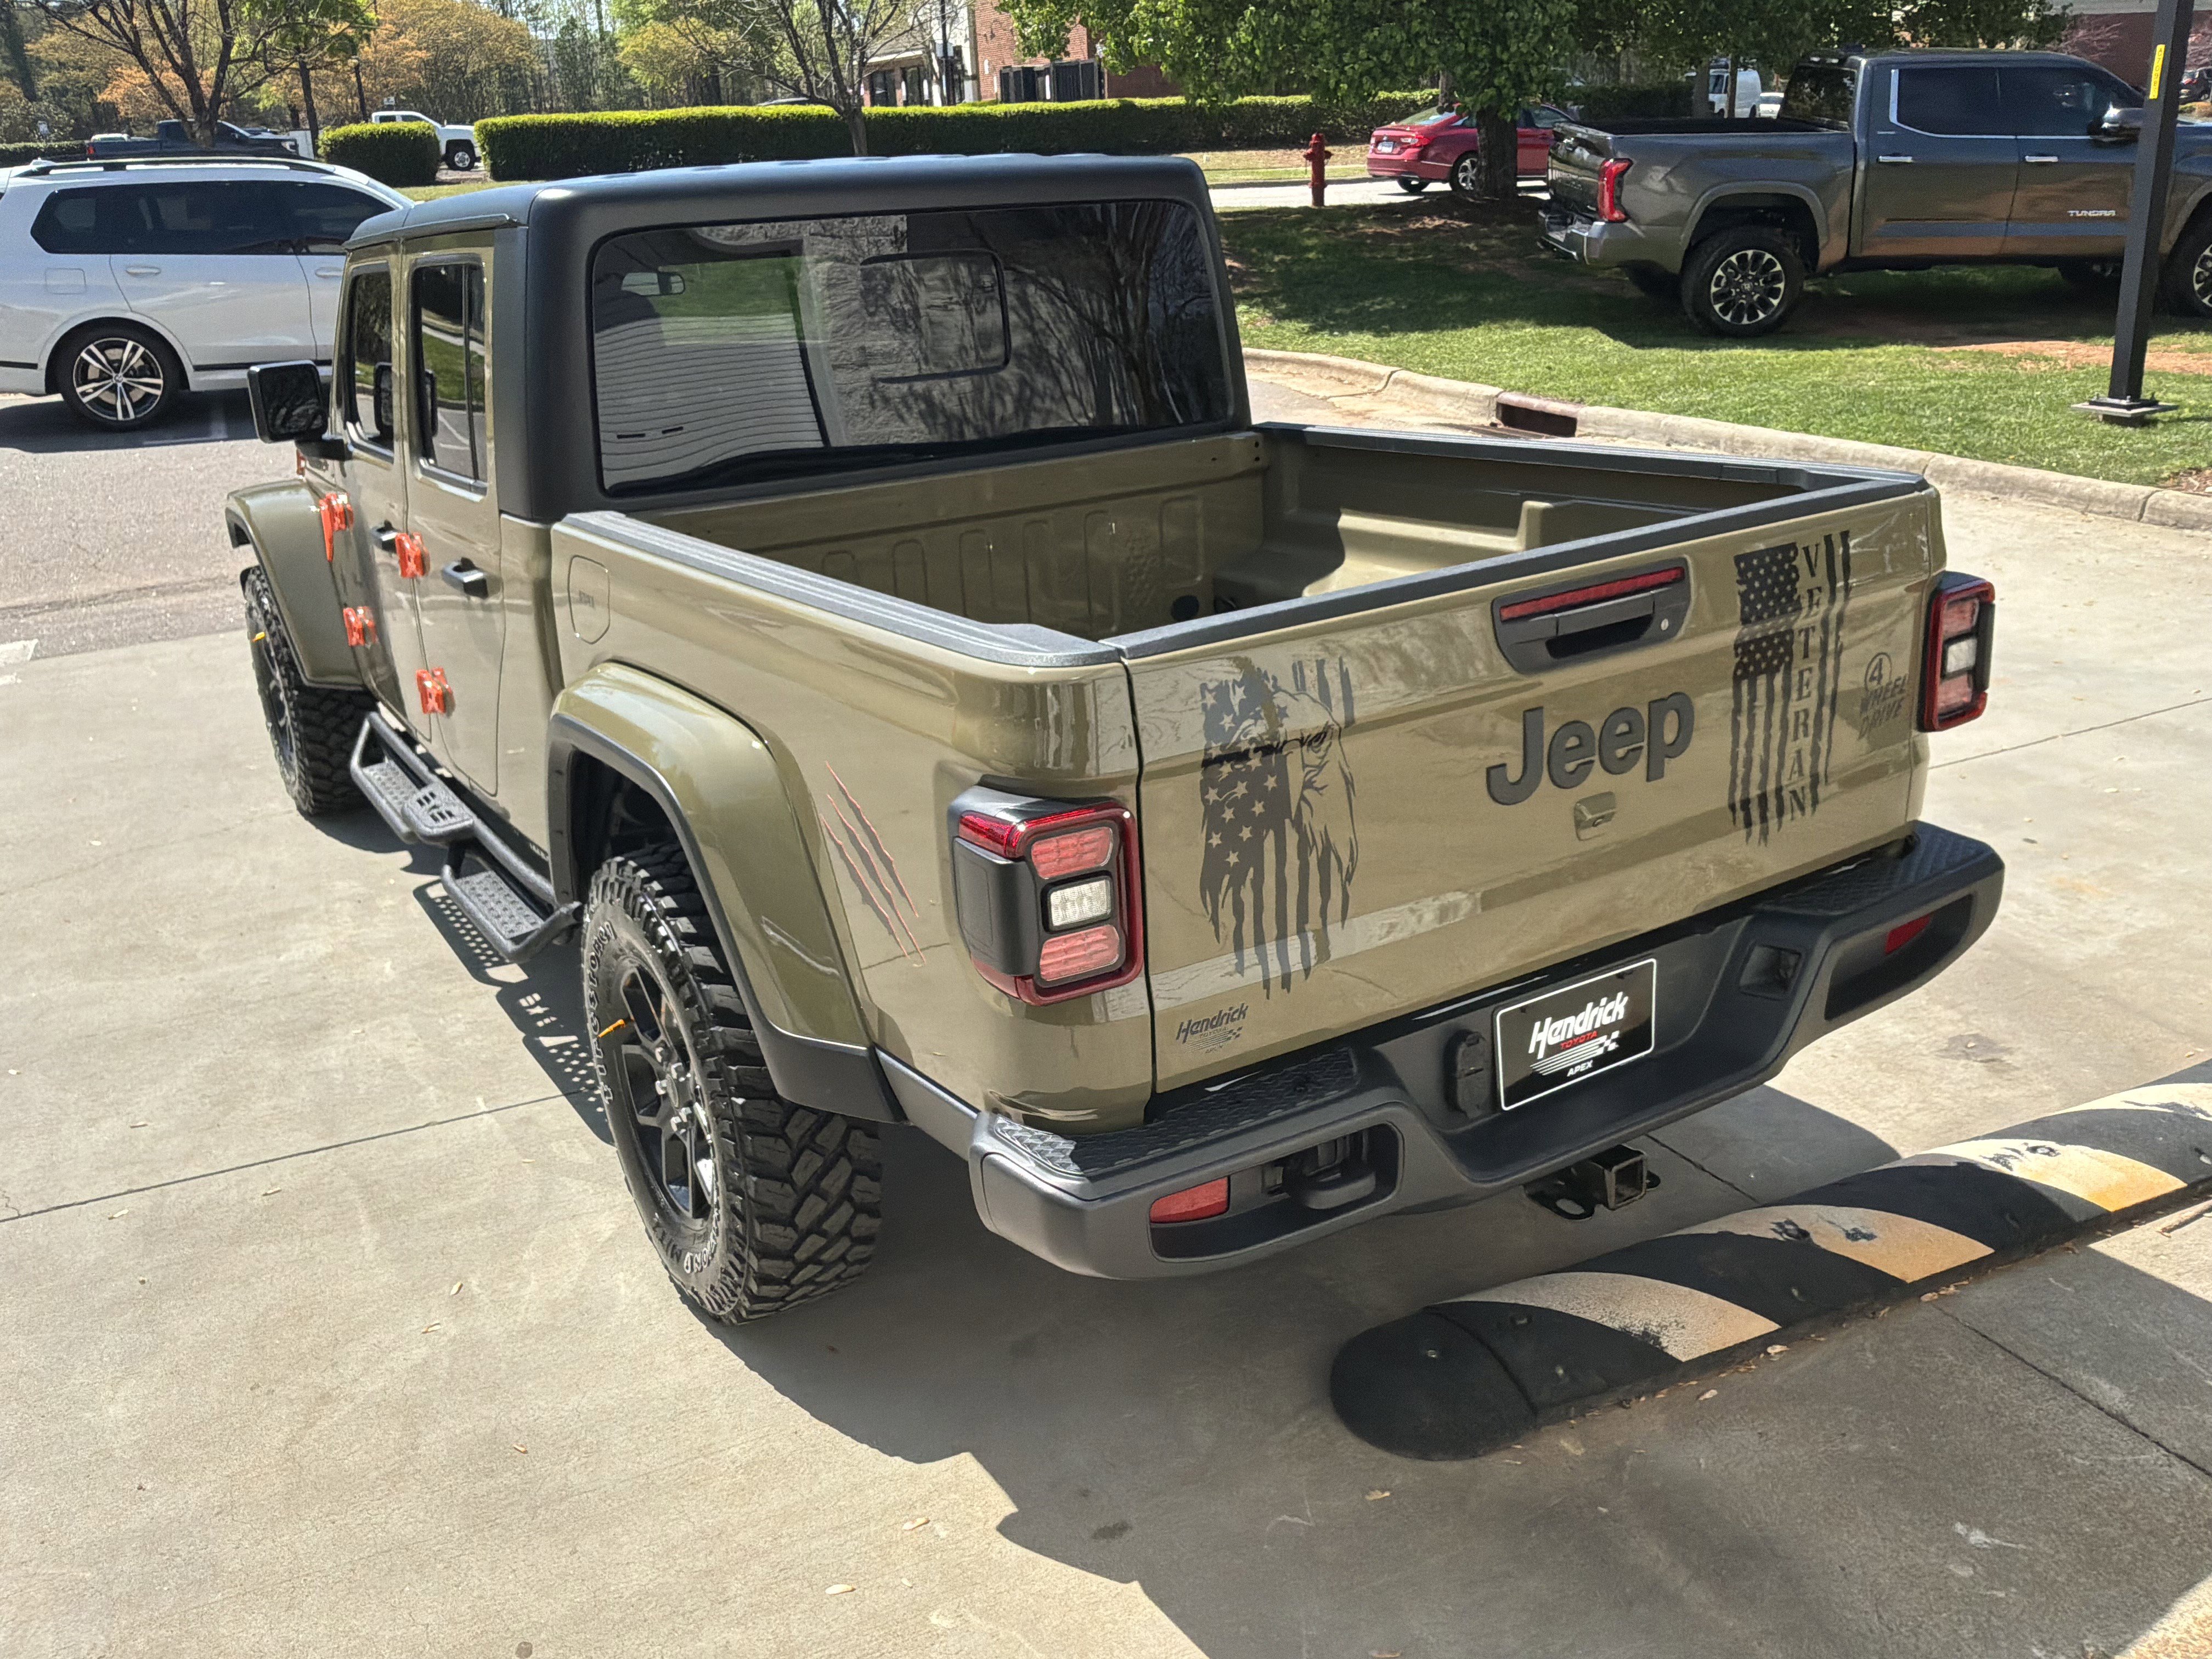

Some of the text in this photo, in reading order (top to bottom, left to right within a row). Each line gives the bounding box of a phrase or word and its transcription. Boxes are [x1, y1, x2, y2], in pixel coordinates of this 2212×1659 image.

[1788, 543, 1822, 821] VETERAN
[1858, 697, 1905, 740] DRIVE
[1486, 692, 1695, 805] Jeep
[1176, 1003, 1249, 1044] Hendrick
[1528, 991, 1629, 1059] Hendrick
[1560, 1030, 1598, 1049] TOYOTA
[1567, 1060, 1593, 1076] APEX
